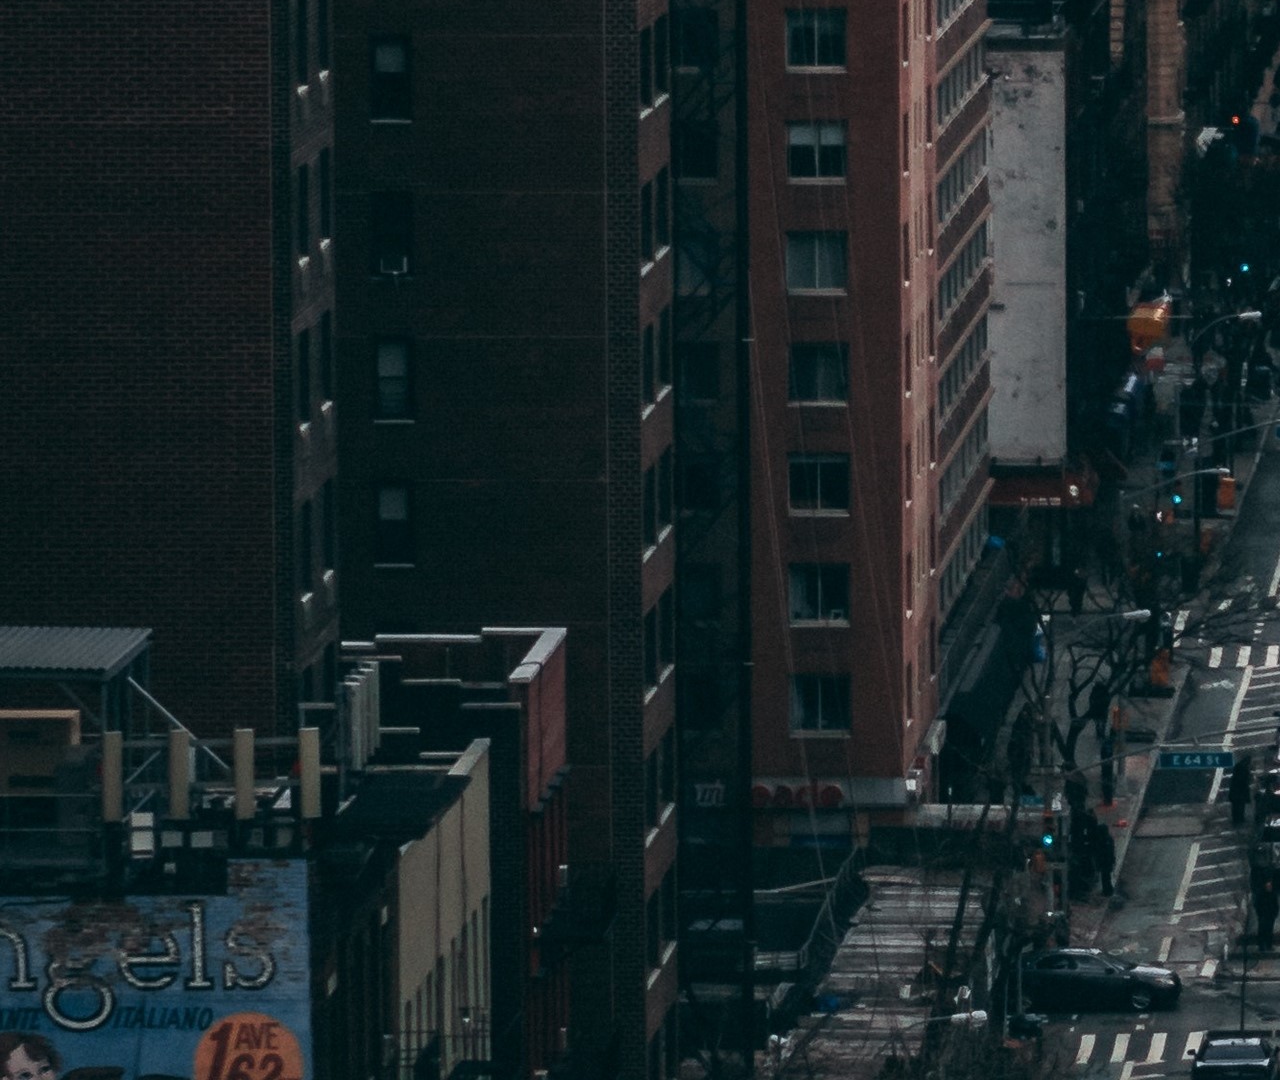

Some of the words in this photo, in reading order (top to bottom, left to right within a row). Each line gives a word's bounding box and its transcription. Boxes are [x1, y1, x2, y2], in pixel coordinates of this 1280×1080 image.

[1184, 755, 1202, 766] 64
[113, 1006, 214, 1031] ITALIANO
[234, 1022, 280, 1051] AVE
